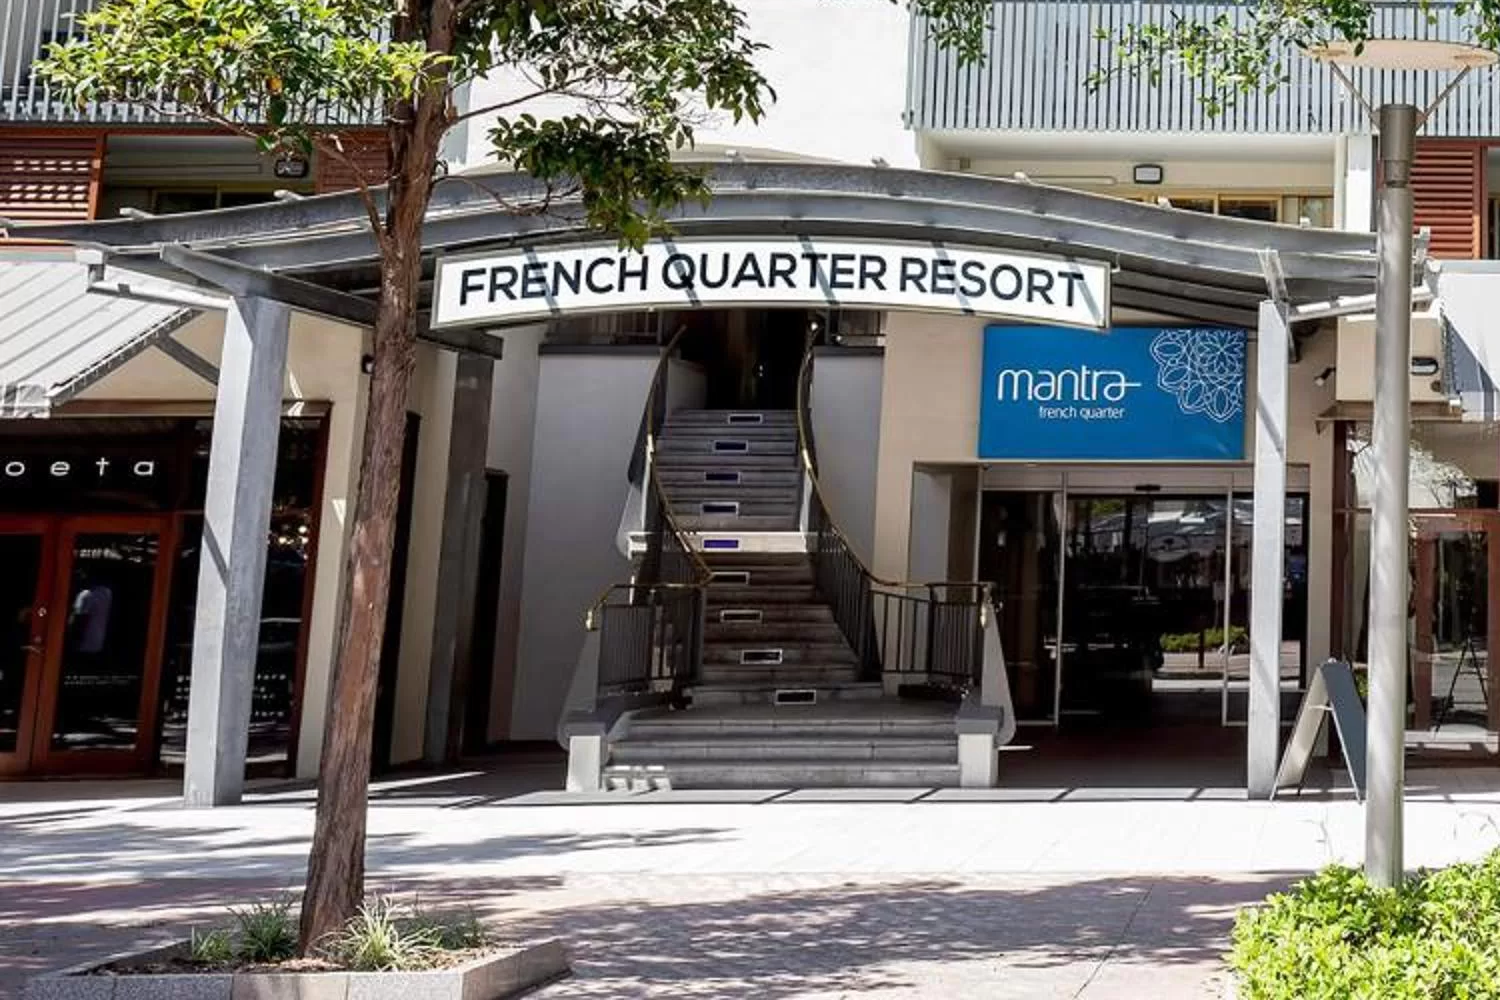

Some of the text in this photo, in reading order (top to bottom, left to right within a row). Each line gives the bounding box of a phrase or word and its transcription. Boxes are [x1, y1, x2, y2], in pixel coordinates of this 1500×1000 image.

[459, 248, 1084, 307] FRENCH QUARTER RESORT
[998, 365, 1142, 401] mantra
[1039, 406, 1125, 421] french quarter
